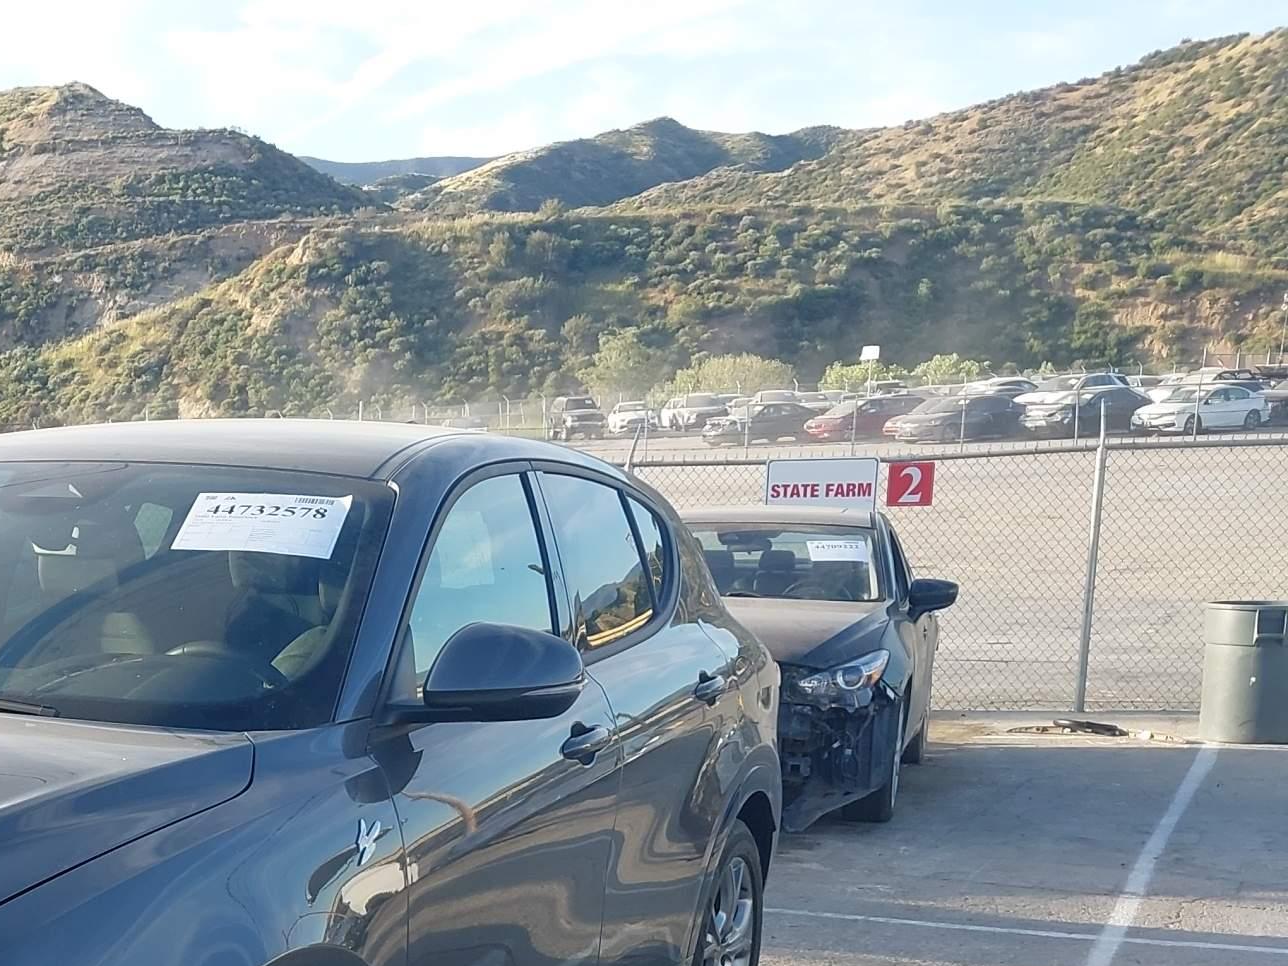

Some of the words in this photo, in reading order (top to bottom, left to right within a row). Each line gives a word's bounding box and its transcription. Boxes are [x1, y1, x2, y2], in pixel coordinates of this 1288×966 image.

[770, 483, 819, 498] STATE
[825, 482, 872, 498] FARM
[897, 466, 922, 503] 2
[206, 504, 328, 520] 44732578
